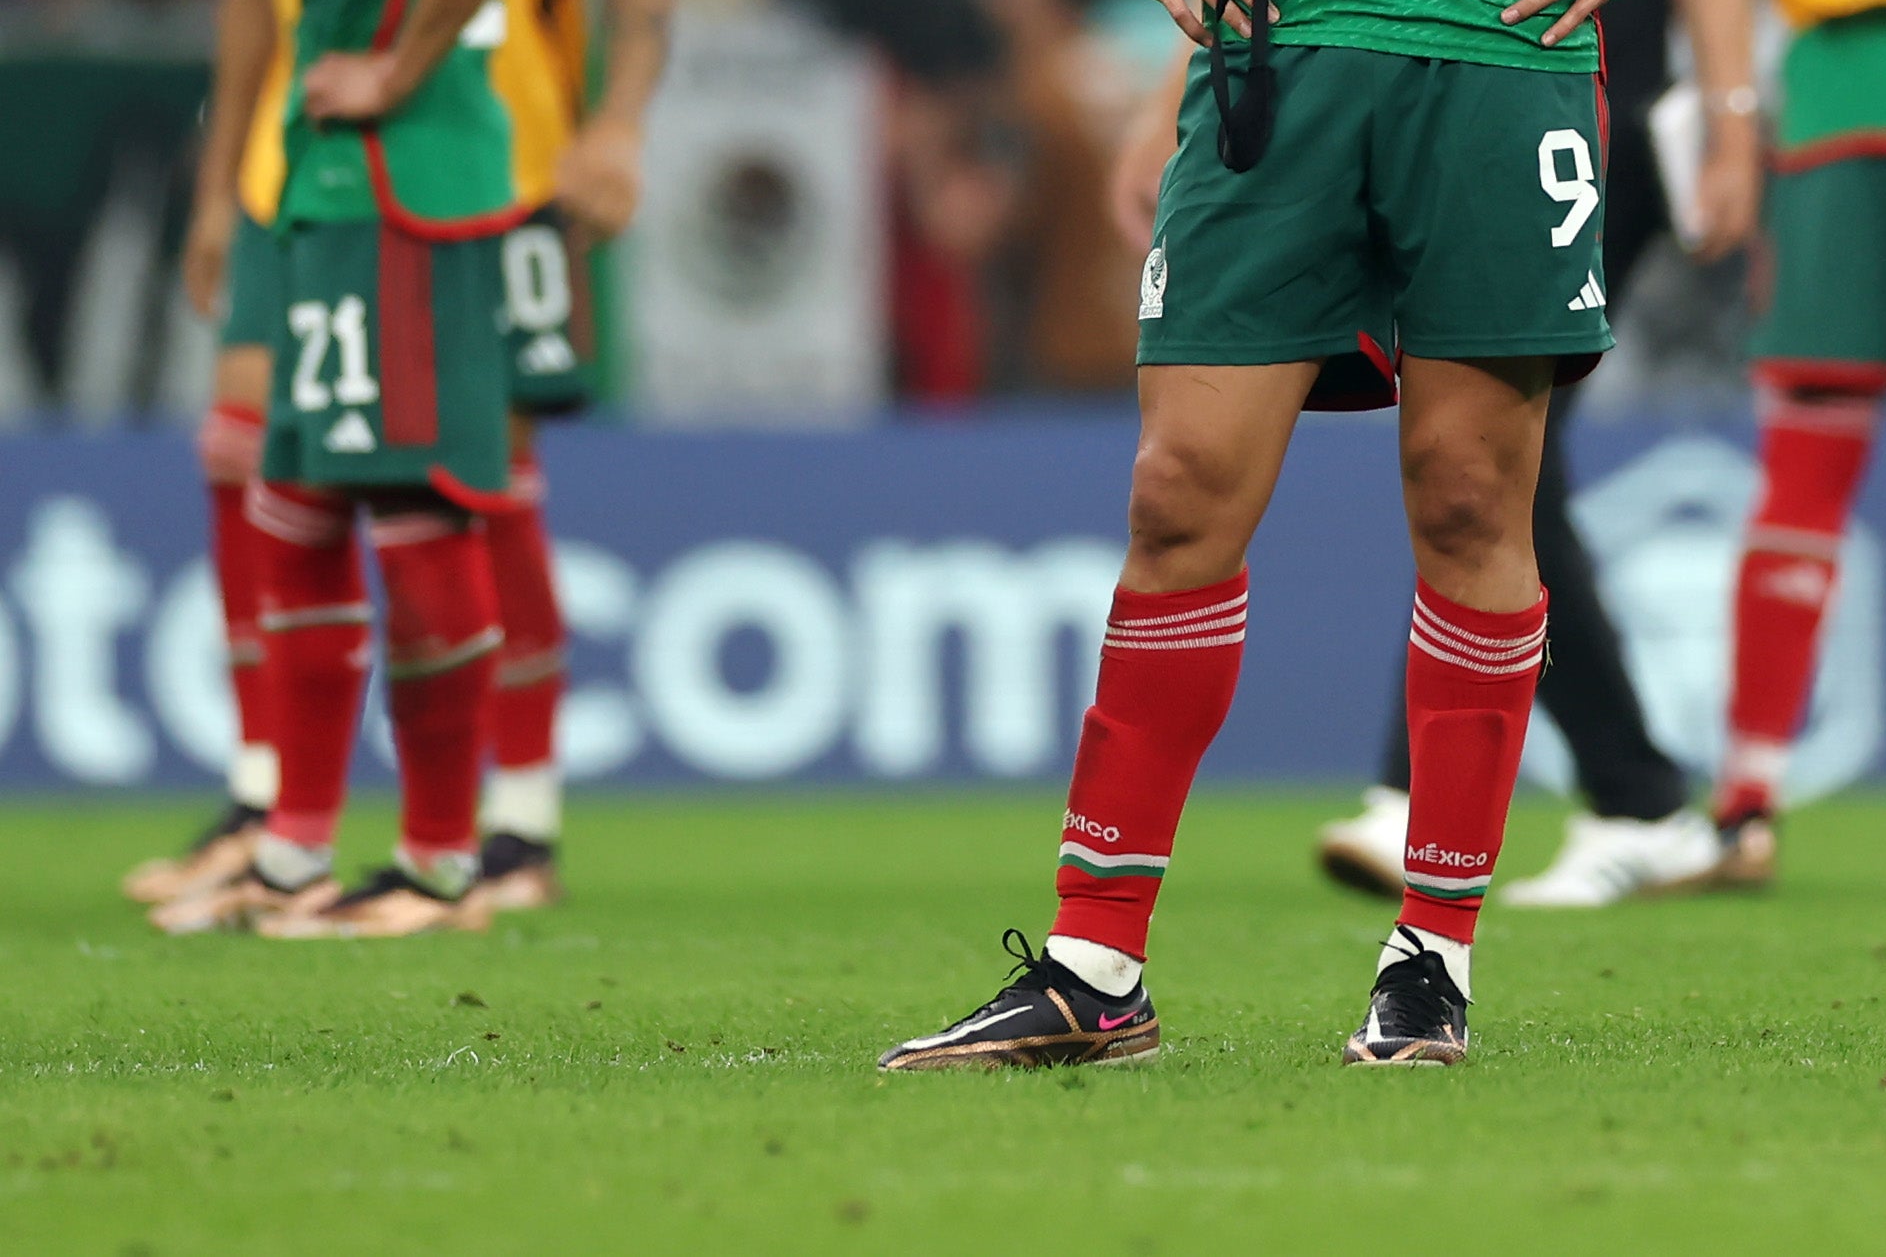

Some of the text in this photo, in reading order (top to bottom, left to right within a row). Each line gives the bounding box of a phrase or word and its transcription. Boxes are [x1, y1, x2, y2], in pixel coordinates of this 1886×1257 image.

[1538, 129, 1600, 247] 9
[494, 225, 572, 332] 0
[288, 294, 379, 411] 21
[1063, 807, 1120, 843] ÉXICO
[1407, 843, 1488, 868] MÉXICO
